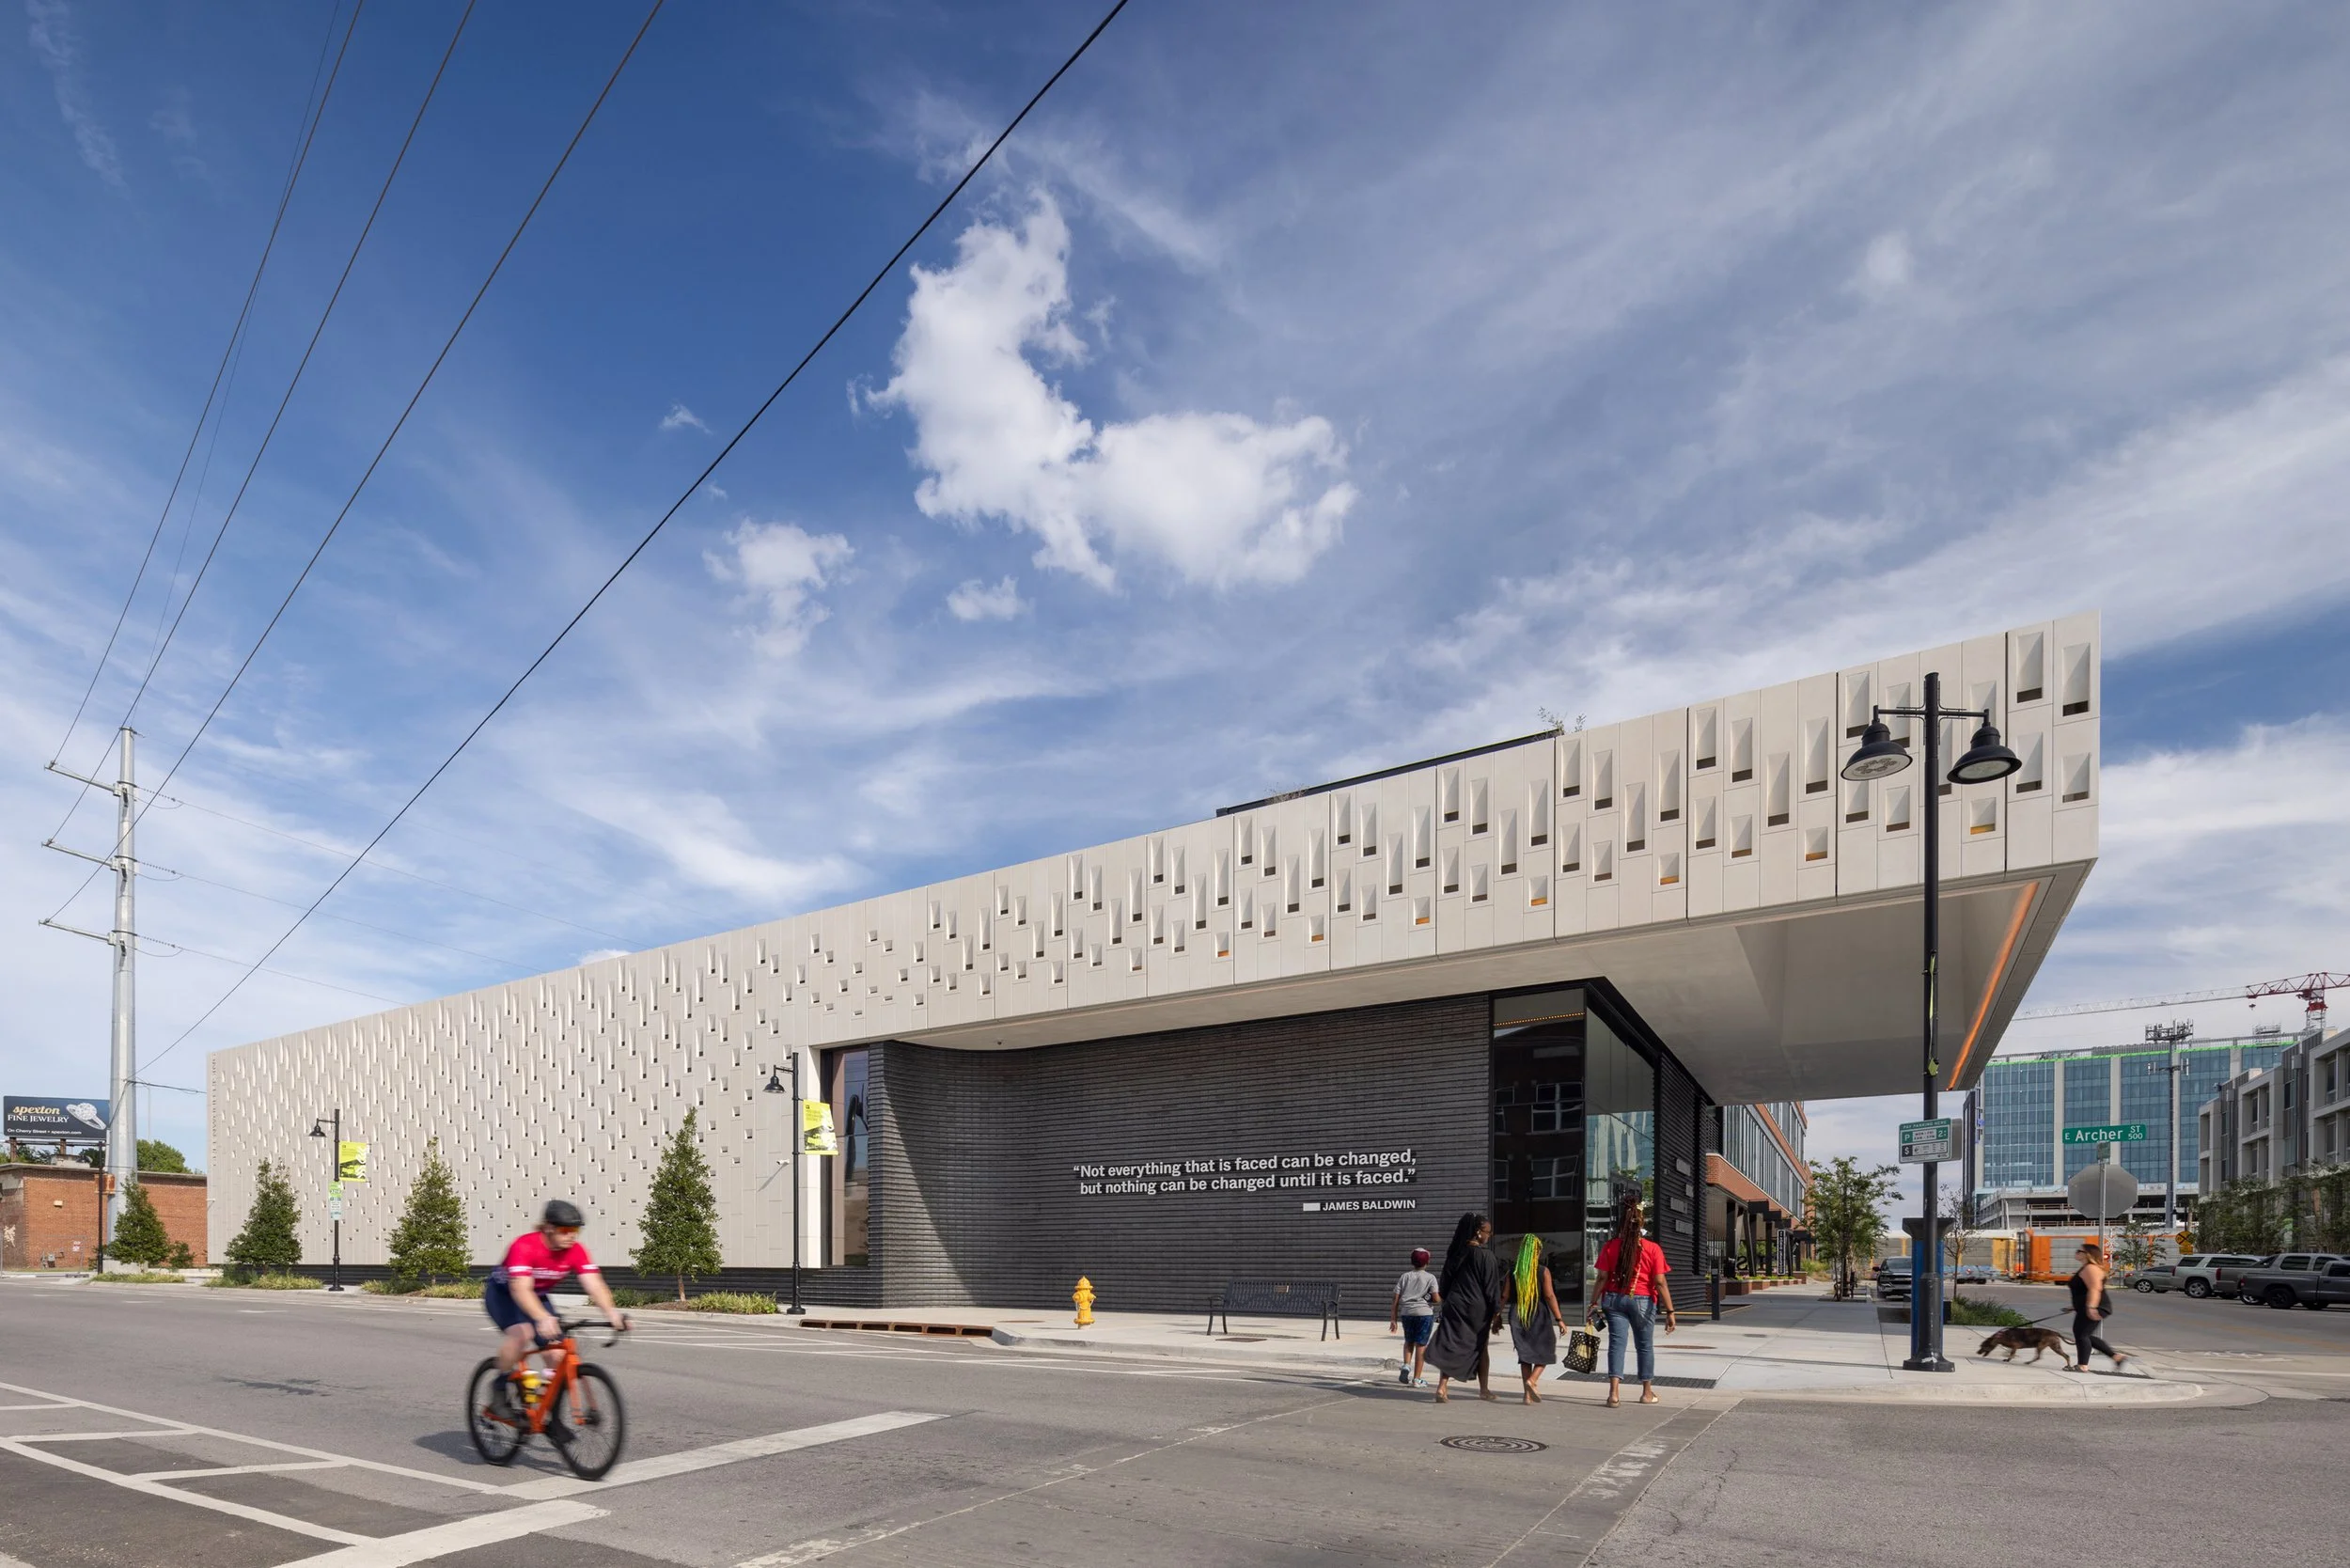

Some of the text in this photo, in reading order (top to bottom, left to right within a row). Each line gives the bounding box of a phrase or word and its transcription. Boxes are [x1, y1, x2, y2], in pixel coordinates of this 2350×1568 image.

[2064, 1125, 2141, 1142] E Archer ST
[1108, 1161, 1182, 1178] everything
[1184, 1160, 1215, 1173] that
[1219, 1158, 1231, 1171] is
[1235, 1155, 1277, 1170] faced
[1281, 1157, 1310, 1168] can
[1315, 1152, 1335, 1167] be
[1339, 1149, 1417, 1167] changed,
[1081, 1183, 1103, 1195] but
[1105, 1180, 1157, 1196] nothing
[1160, 1181, 1185, 1192] can
[1190, 1178, 1208, 1190] be
[1211, 1174, 1276, 1192] changed
[1279, 1172, 1316, 1187] until
[1321, 1172, 1333, 1186] it
[1338, 1171, 1352, 1185] is
[1323, 1200, 1416, 1211] JAMES BALDWIN
